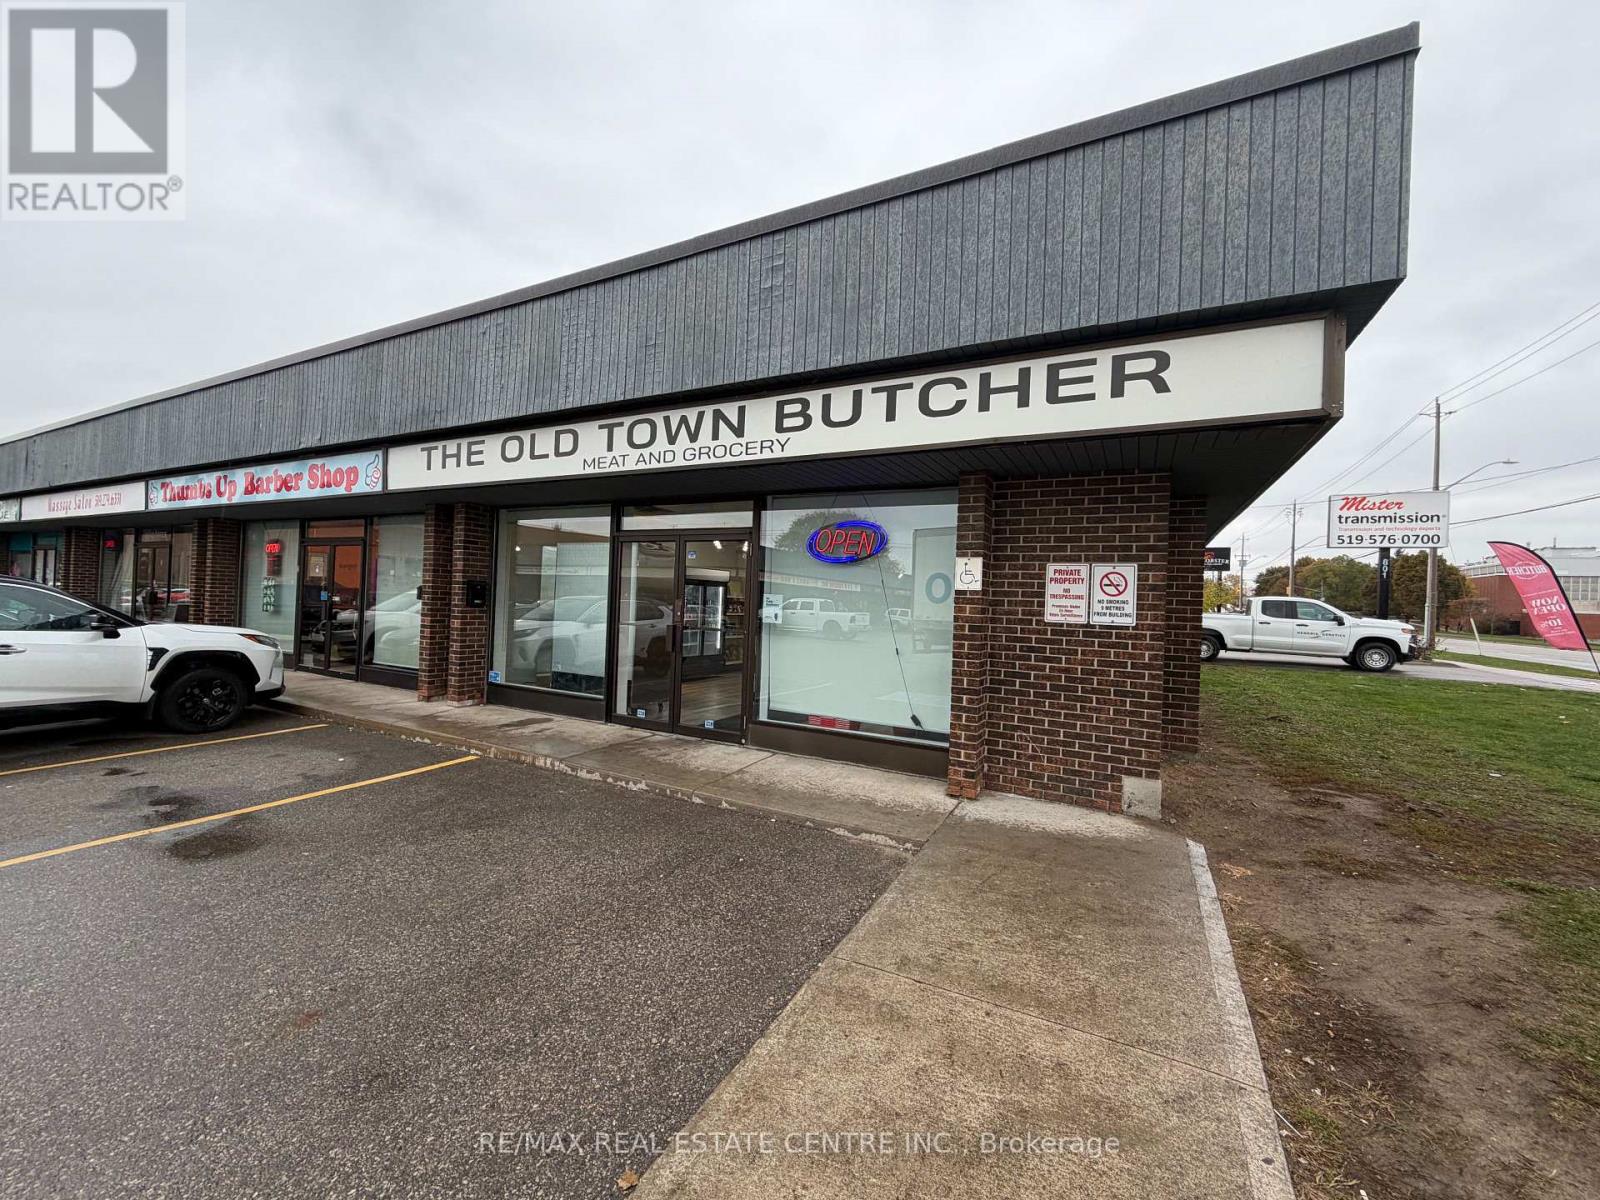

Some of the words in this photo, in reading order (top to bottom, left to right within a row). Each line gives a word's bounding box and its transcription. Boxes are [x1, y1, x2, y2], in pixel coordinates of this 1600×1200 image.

[420, 439, 486, 471] THE
[500, 428, 579, 463] OLD
[598, 405, 746, 452] TOWN
[774, 349, 1171, 434] BUTCHER
[582, 454, 630, 471] MEAT
[635, 449, 676, 466] AND
[683, 437, 791, 462] GROCERY
[160, 479, 212, 502] Thumbs
[215, 475, 237, 502] Up
[243, 469, 303, 496] Barber
[307, 463, 359, 492] Shop
[1339, 496, 1405, 512] Mister
[1337, 512, 1440, 524] transmission
[815, 528, 875, 557] OPEN
[1050, 577, 1085, 585] PROPERTY
[1054, 569, 1082, 577] PRIVATE
